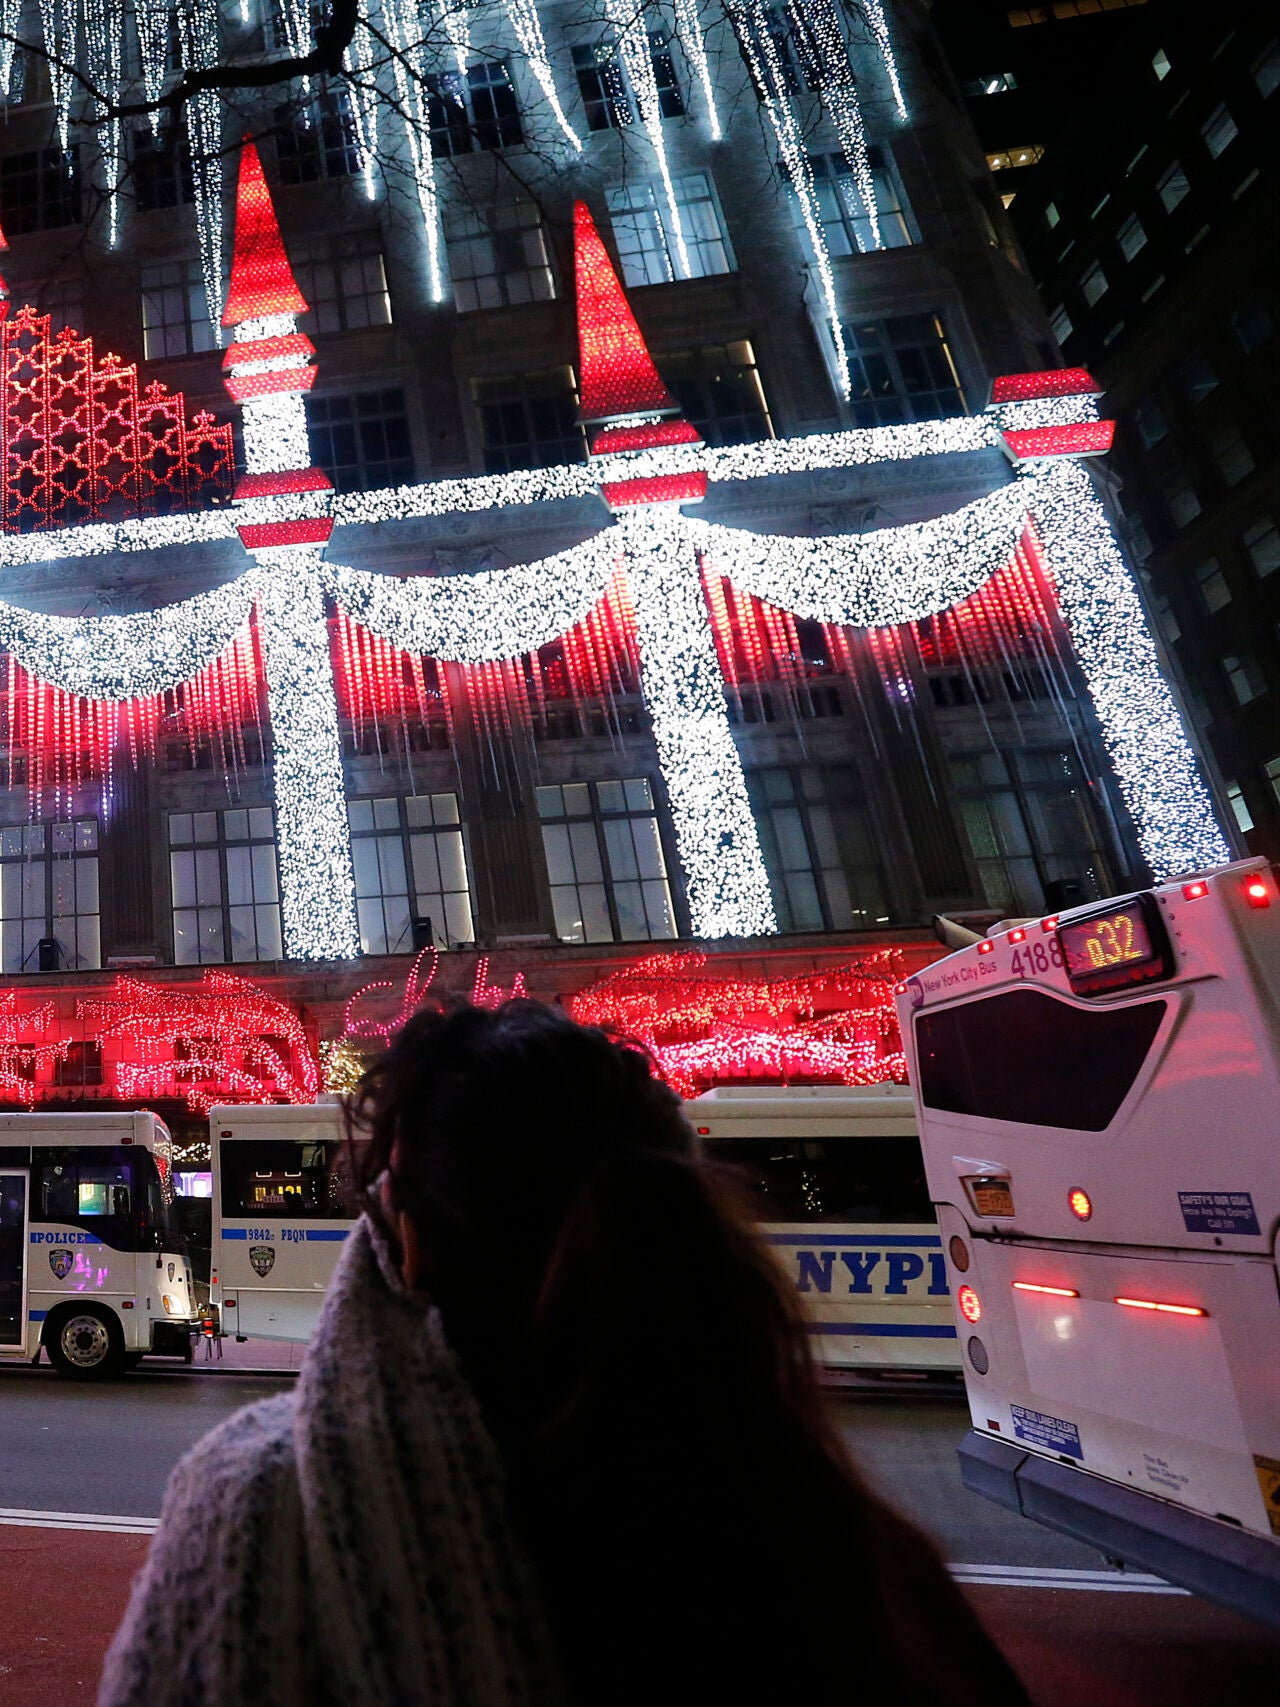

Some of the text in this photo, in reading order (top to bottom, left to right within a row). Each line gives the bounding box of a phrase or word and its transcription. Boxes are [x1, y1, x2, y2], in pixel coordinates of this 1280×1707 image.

[1011, 937, 1064, 978] 4188
[924, 980, 941, 993] New
[941, 971, 960, 987] York
[961, 967, 978, 981] City
[979, 962, 997, 975] Bus
[37, 1232, 85, 1244] POLICE
